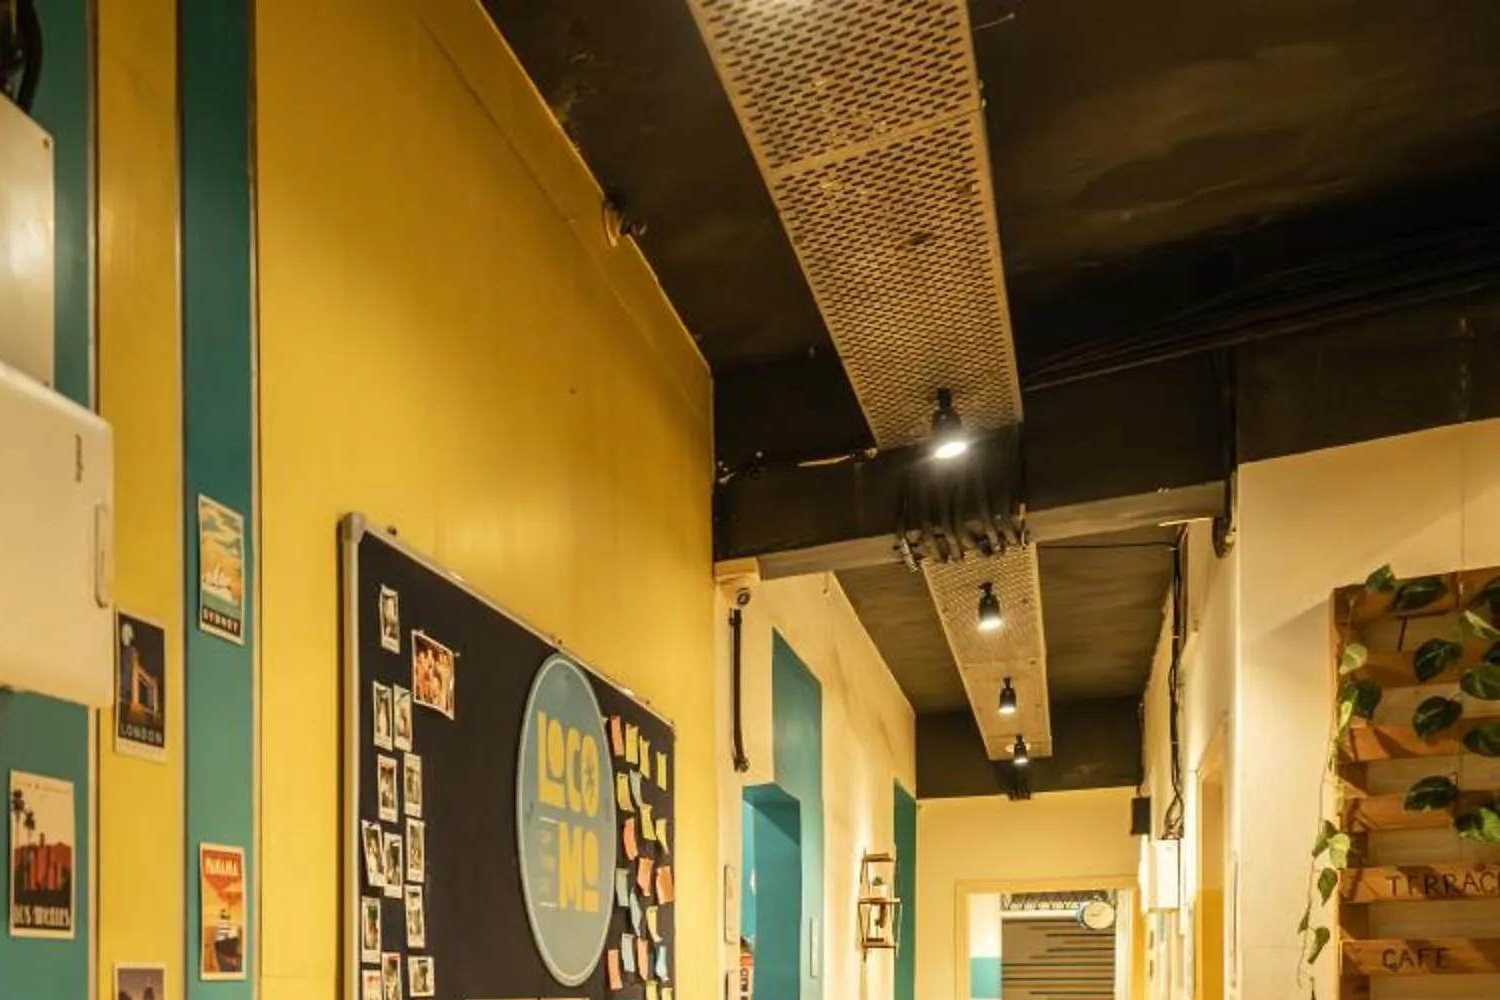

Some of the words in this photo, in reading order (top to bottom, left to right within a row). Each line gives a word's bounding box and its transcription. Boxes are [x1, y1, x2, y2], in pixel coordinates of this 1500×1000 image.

[119, 723, 163, 745] LONDON
[537, 709, 599, 817] LOCO
[1385, 871, 1500, 897] TERRAC
[1382, 947, 1449, 973] CAFE
